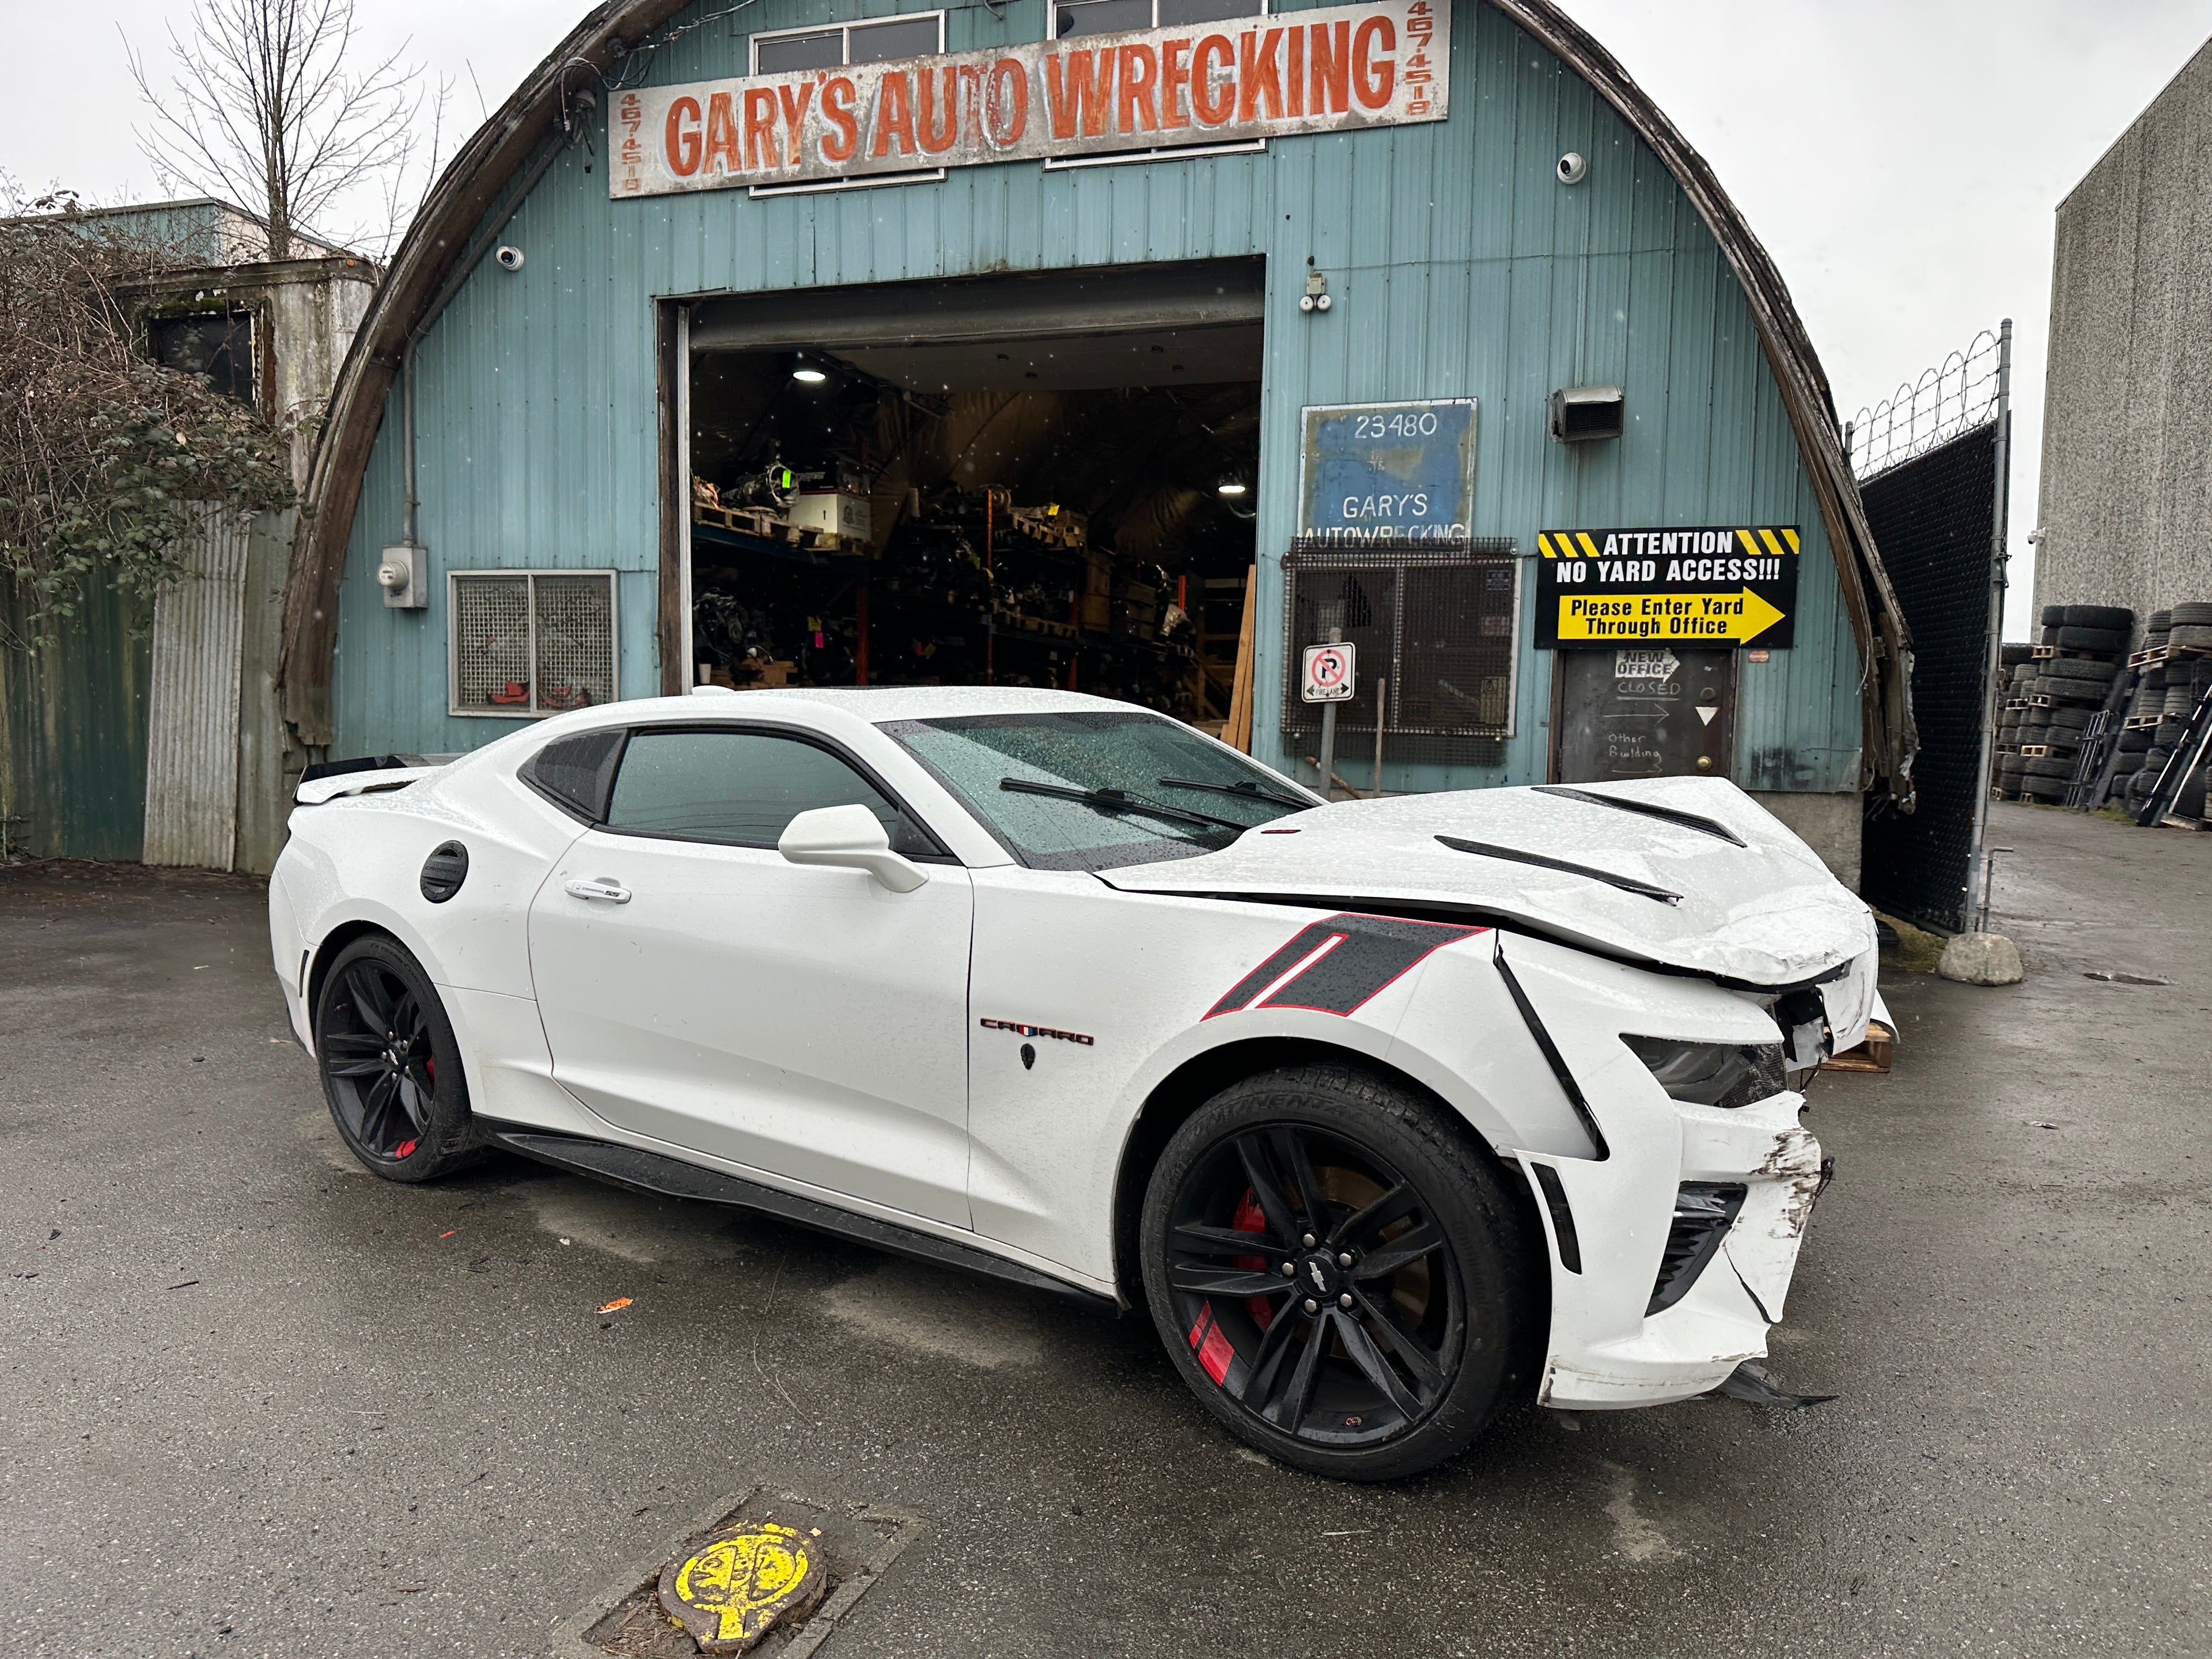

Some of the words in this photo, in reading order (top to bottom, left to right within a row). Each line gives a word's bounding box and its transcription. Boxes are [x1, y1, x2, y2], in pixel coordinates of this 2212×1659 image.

[665, 72, 858, 177] GARY'S
[873, 58, 1028, 157] AUTO
[1046, 16, 1396, 139] WRECKING
[1354, 412, 1438, 439] 23480
[1343, 494, 1427, 518] GARY'S
[1603, 531, 1733, 556] ATTENTION
[1556, 560, 1586, 583] NO
[1597, 560, 1656, 582] YARD
[1666, 558, 1780, 581] ACCESS!!!
[1571, 599, 1632, 616] Please
[1641, 598, 1692, 615] Enter
[1701, 597, 1744, 615] Yard
[1585, 618, 1660, 637] Through
[1670, 616, 1728, 634] Office
[1624, 651, 1664, 662] NEW
[1617, 662, 1672, 675] OFFICE
[1618, 681, 1681, 695] CLOSED
[1608, 733, 1646, 743] Other
